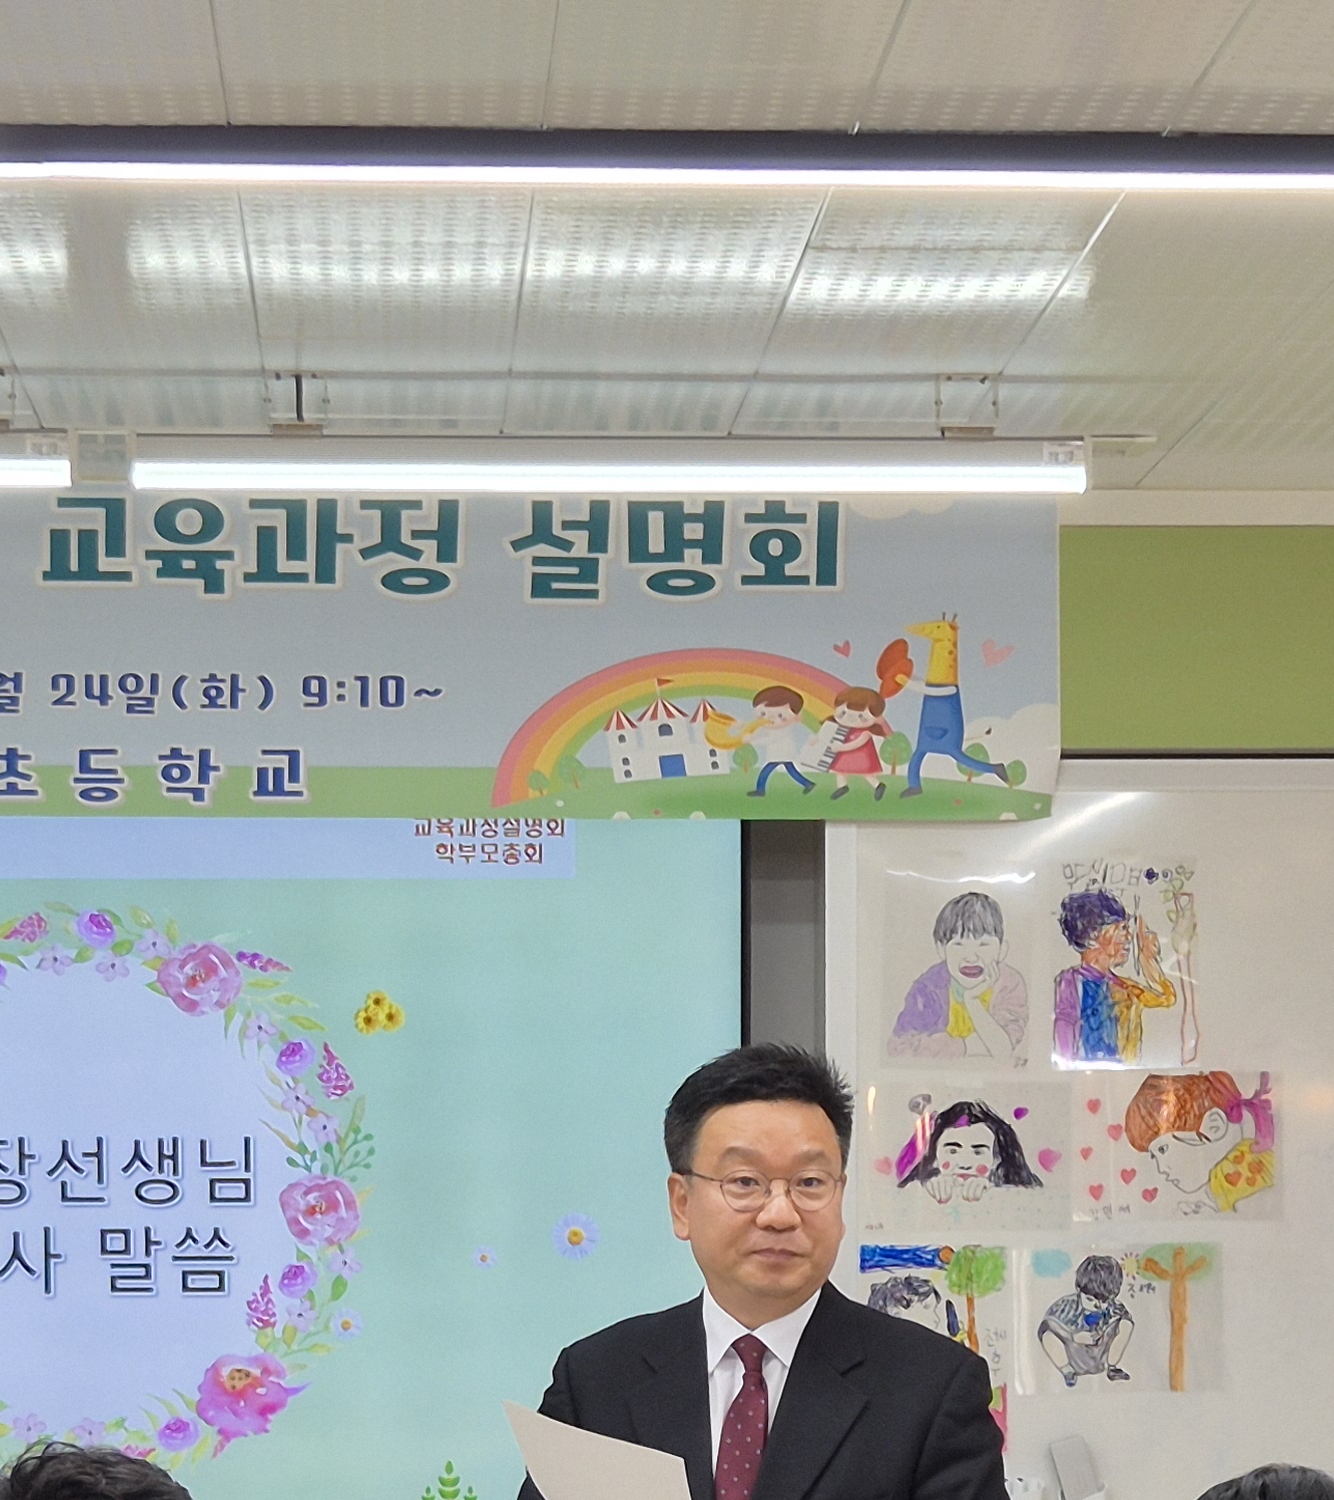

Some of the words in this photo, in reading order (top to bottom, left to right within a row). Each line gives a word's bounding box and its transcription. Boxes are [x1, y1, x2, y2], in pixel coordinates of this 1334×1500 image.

[40, 496, 462, 597] 교육과정
[510, 498, 843, 601] 설명회
[50, 672, 275, 715] 24일(화)
[301, 673, 444, 709] 9:10~
[435, 842, 544, 865] 학부모총회
[98, 1225, 237, 1295] 말씀
